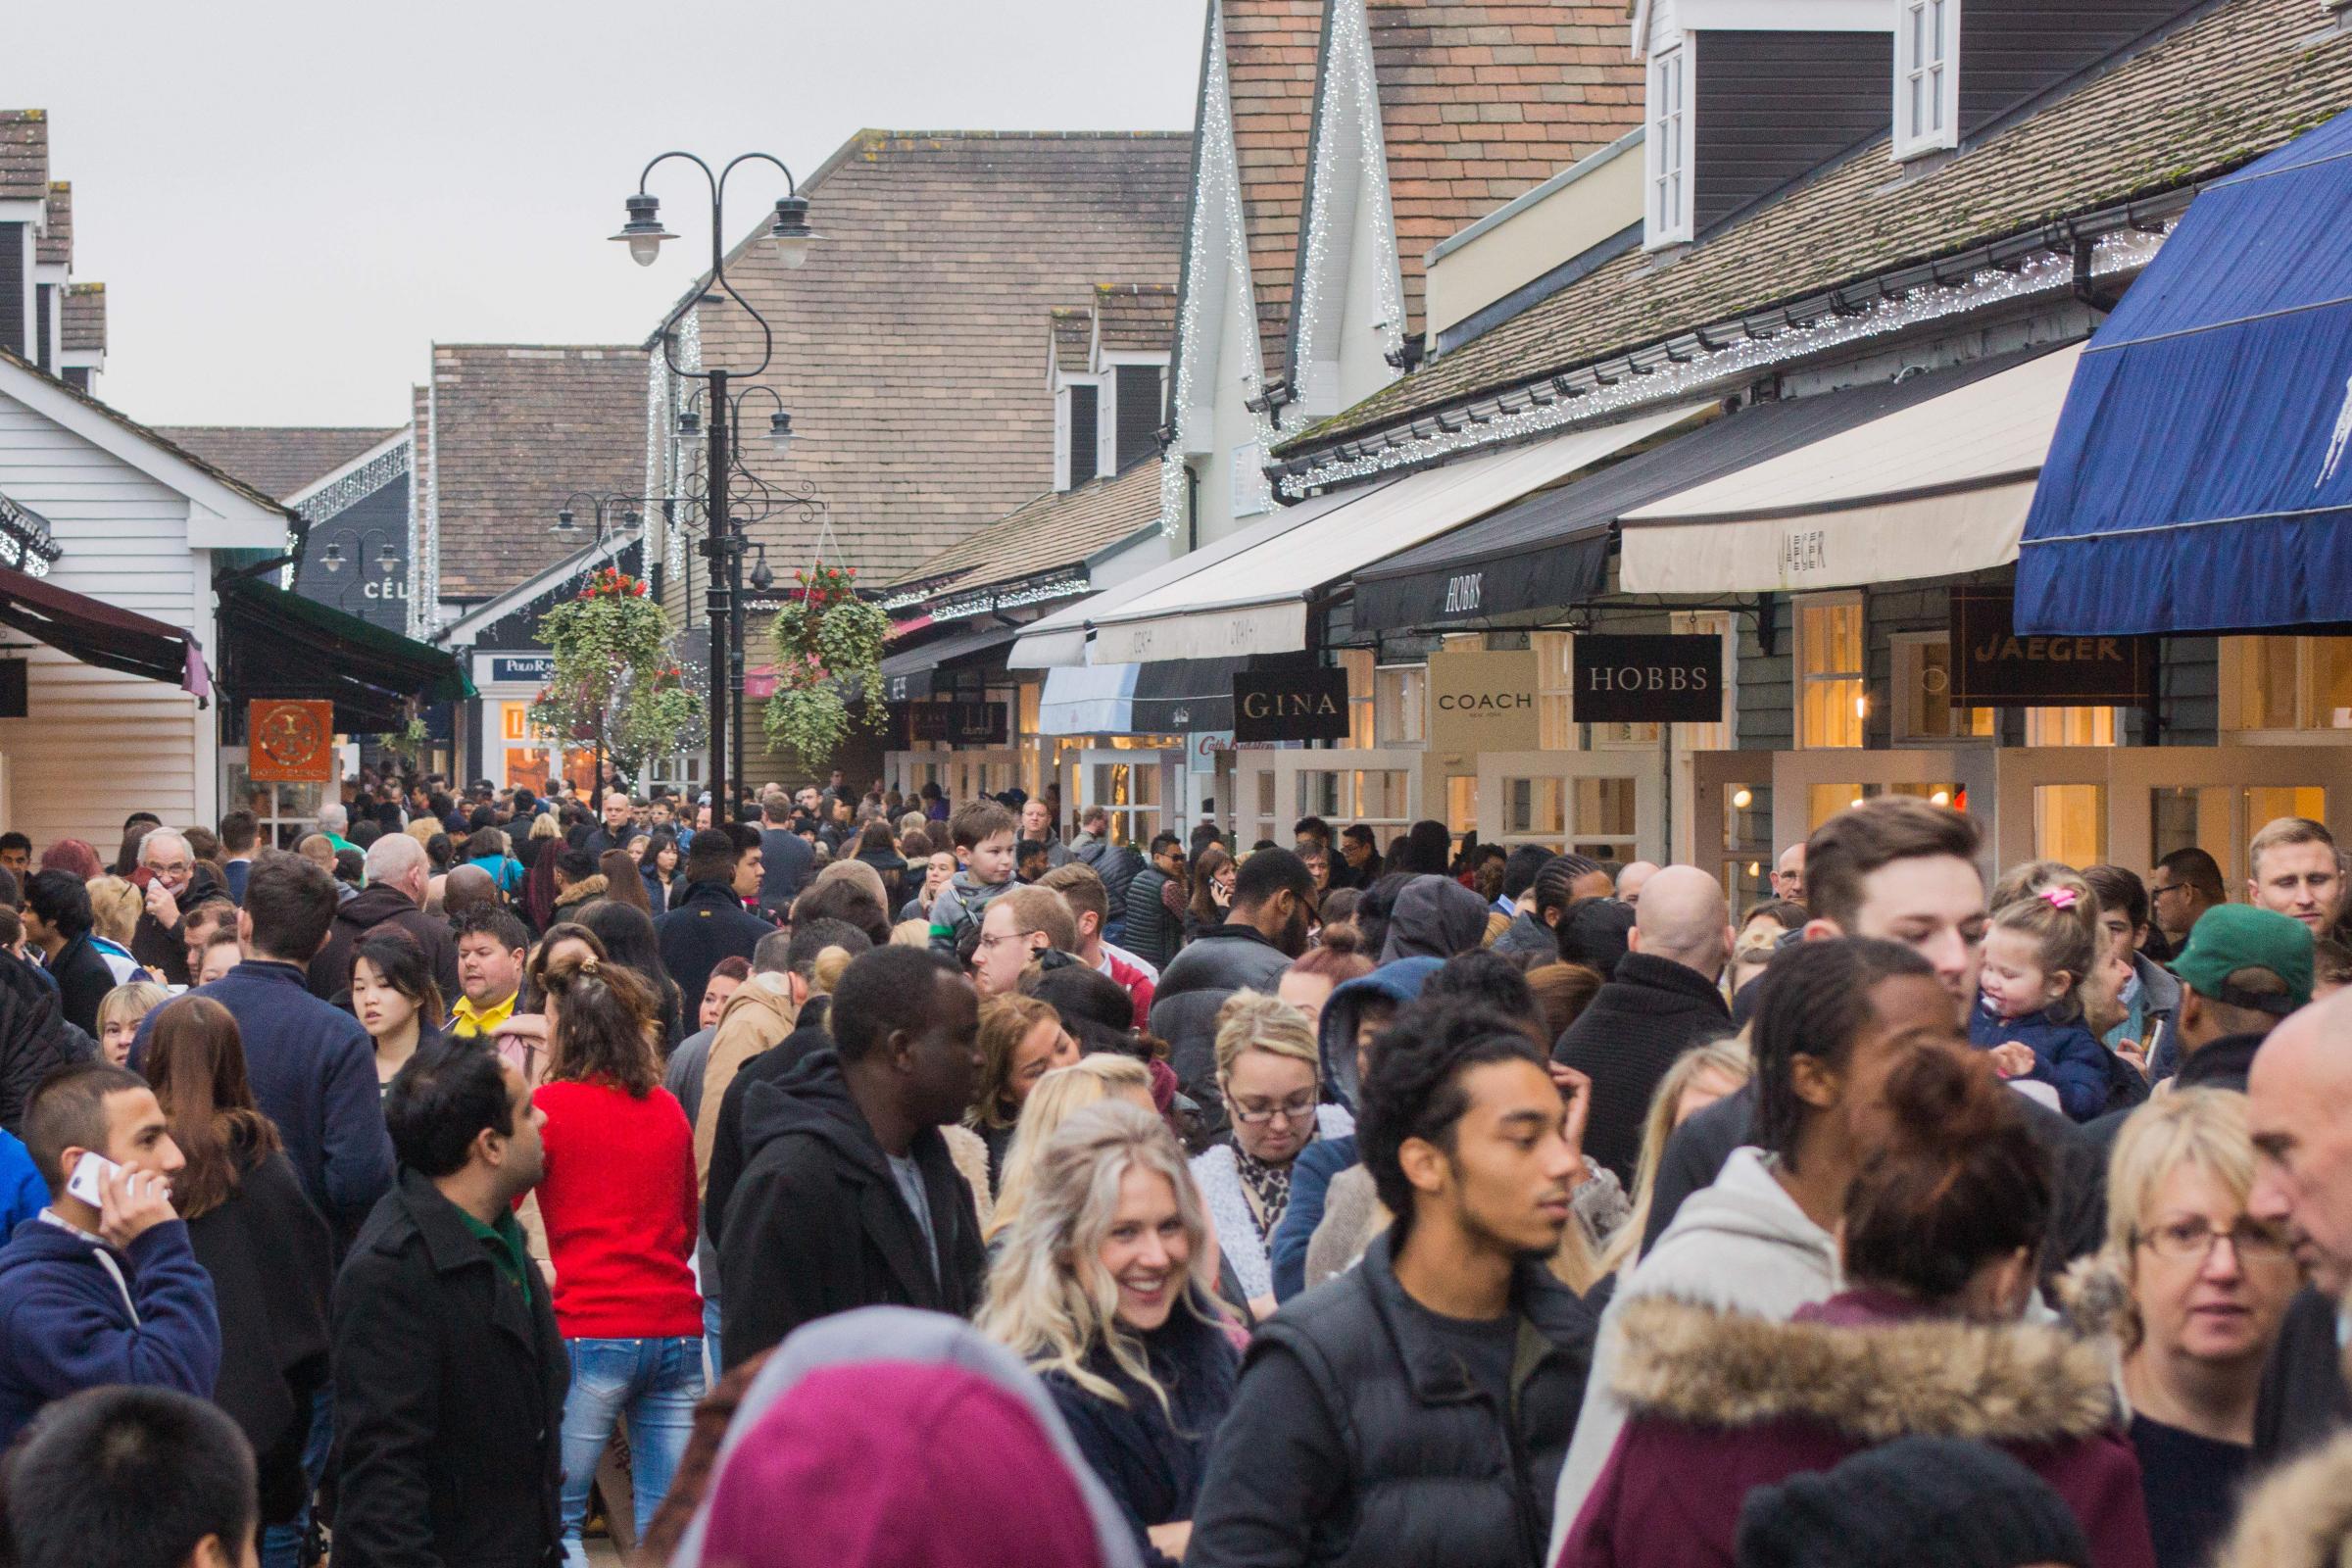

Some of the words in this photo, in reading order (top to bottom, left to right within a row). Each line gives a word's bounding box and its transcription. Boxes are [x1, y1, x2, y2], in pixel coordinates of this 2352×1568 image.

[1445, 571, 1483, 612] HOBBS
[1975, 633, 2125, 662] JAEGER
[1590, 666, 1707, 691] HOBBS
[1244, 692, 1338, 718] GINA
[1439, 692, 1532, 710] COACH
